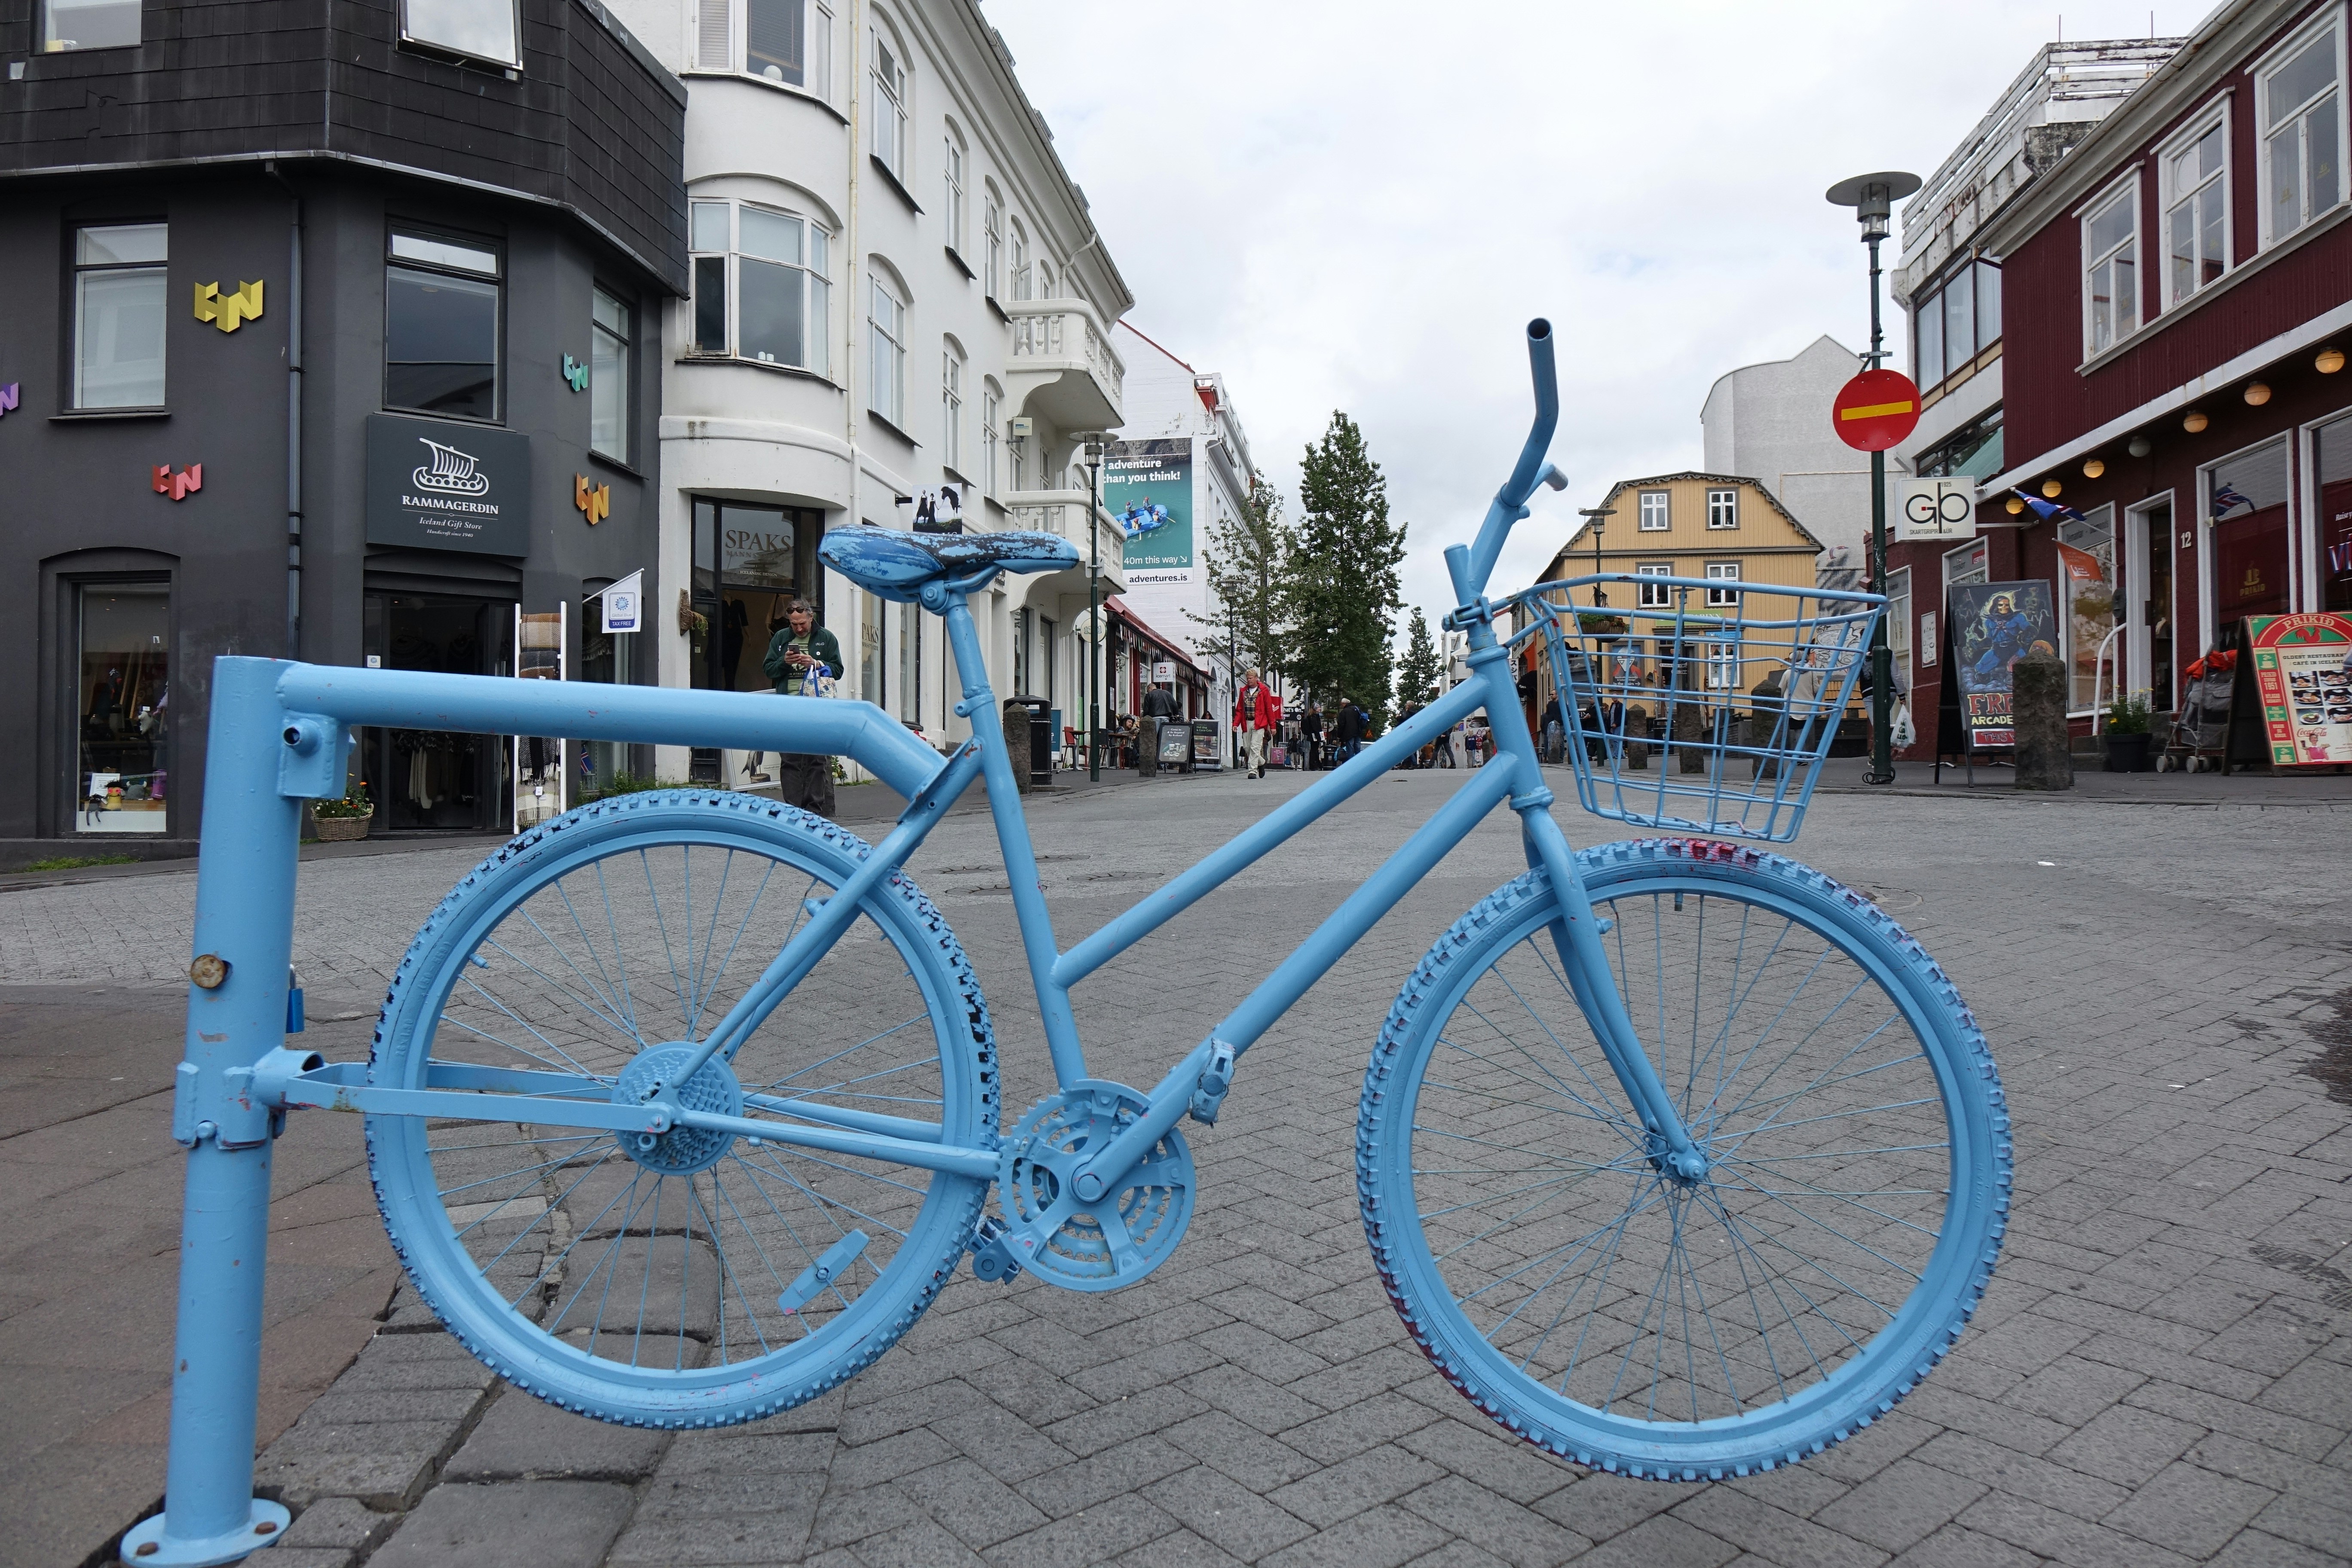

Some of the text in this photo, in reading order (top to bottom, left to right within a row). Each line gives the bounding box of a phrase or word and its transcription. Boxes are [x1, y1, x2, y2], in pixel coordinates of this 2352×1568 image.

[1108, 459, 1161, 470] adventure
[1128, 474, 1146, 484] you
[1149, 471, 1180, 481] think!
[402, 495, 499, 514] RAMMAGERÐIN
[419, 517, 482, 530] Iceland Gift Store
[725, 530, 791, 553] SPAKS
[2180, 531, 2192, 549] 12
[1162, 557, 1178, 565] way
[1129, 573, 1188, 583] adventures.is
[2282, 615, 2334, 629] PRIKIÐ
[862, 622, 879, 644] PAKS
[1967, 692, 2013, 715] FRE
[1971, 715, 2013, 725] ARCADE
[1981, 732, 2008, 742] THIS
